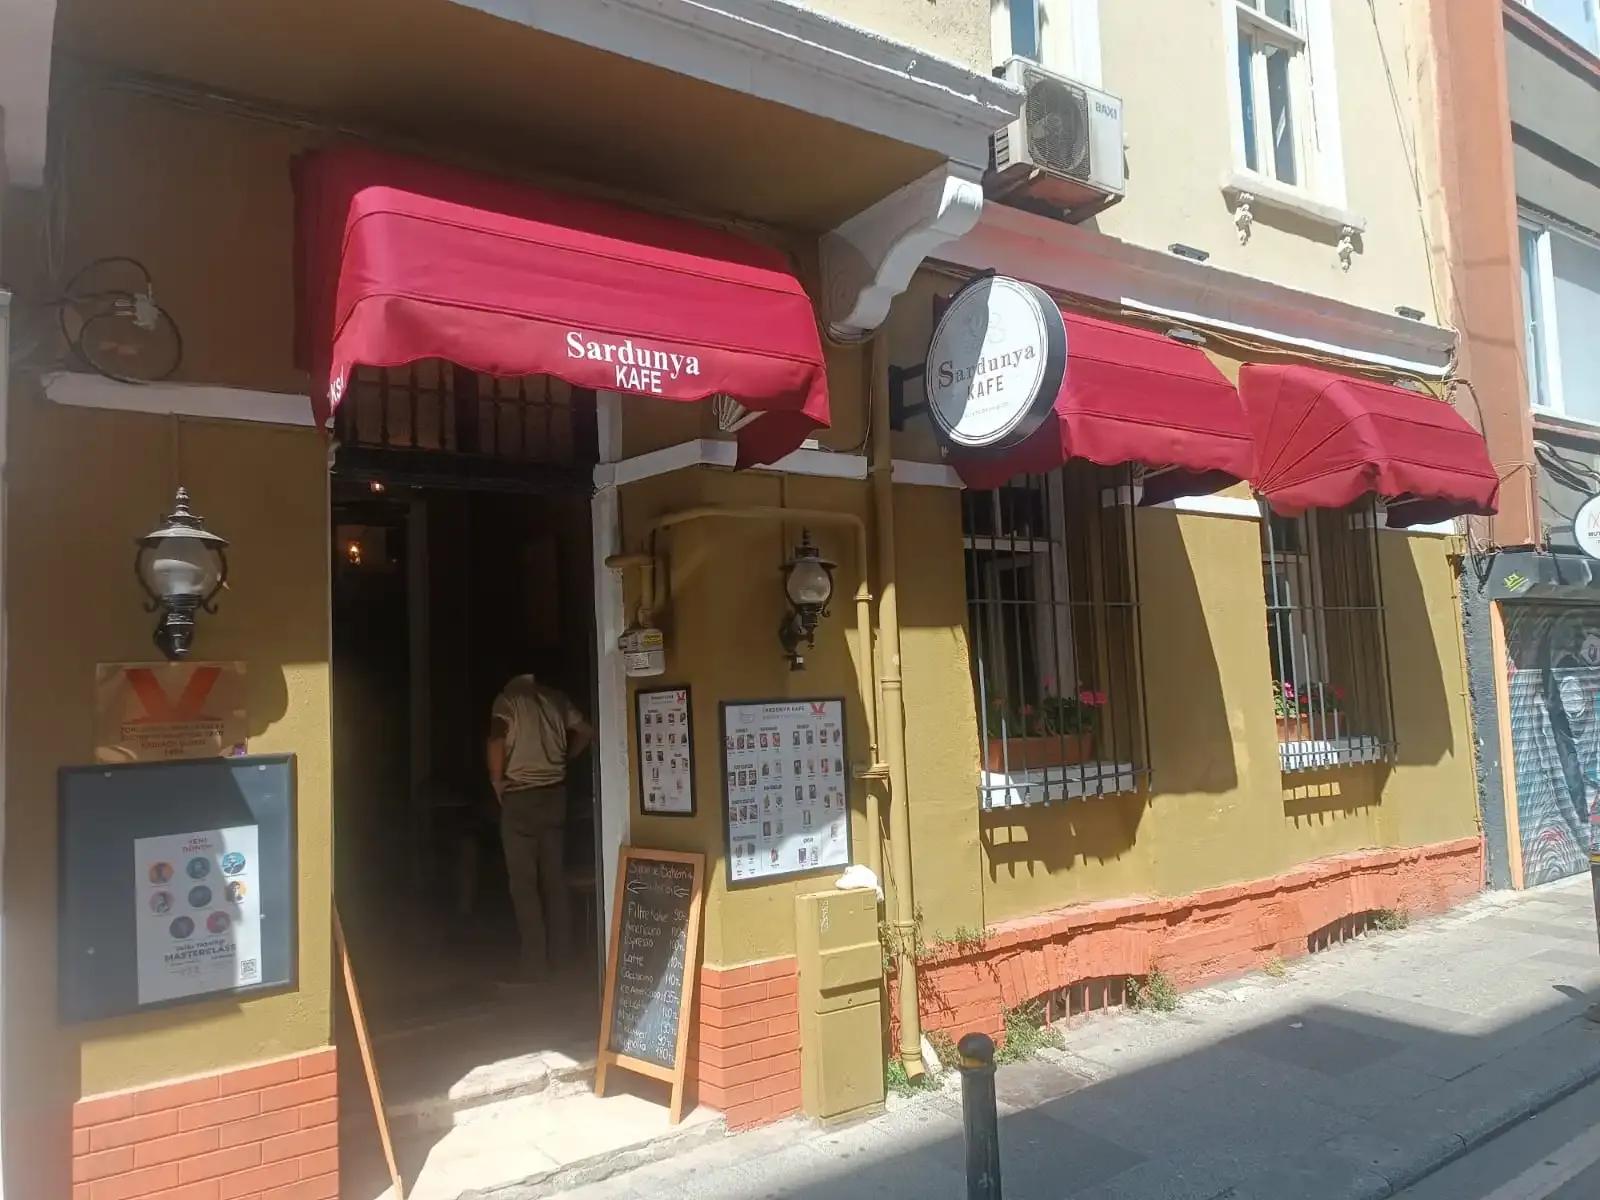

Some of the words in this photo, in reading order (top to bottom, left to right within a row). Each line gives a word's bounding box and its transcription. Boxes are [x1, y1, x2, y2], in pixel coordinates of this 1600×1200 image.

[1095, 101, 1118, 120] BAXI
[566, 331, 700, 379] Sardunya
[939, 345, 1036, 389] Sardunya
[615, 365, 663, 394] KAFE
[967, 375, 1005, 401] KAFE
[164, 943, 237, 962] MASTERCLASS
